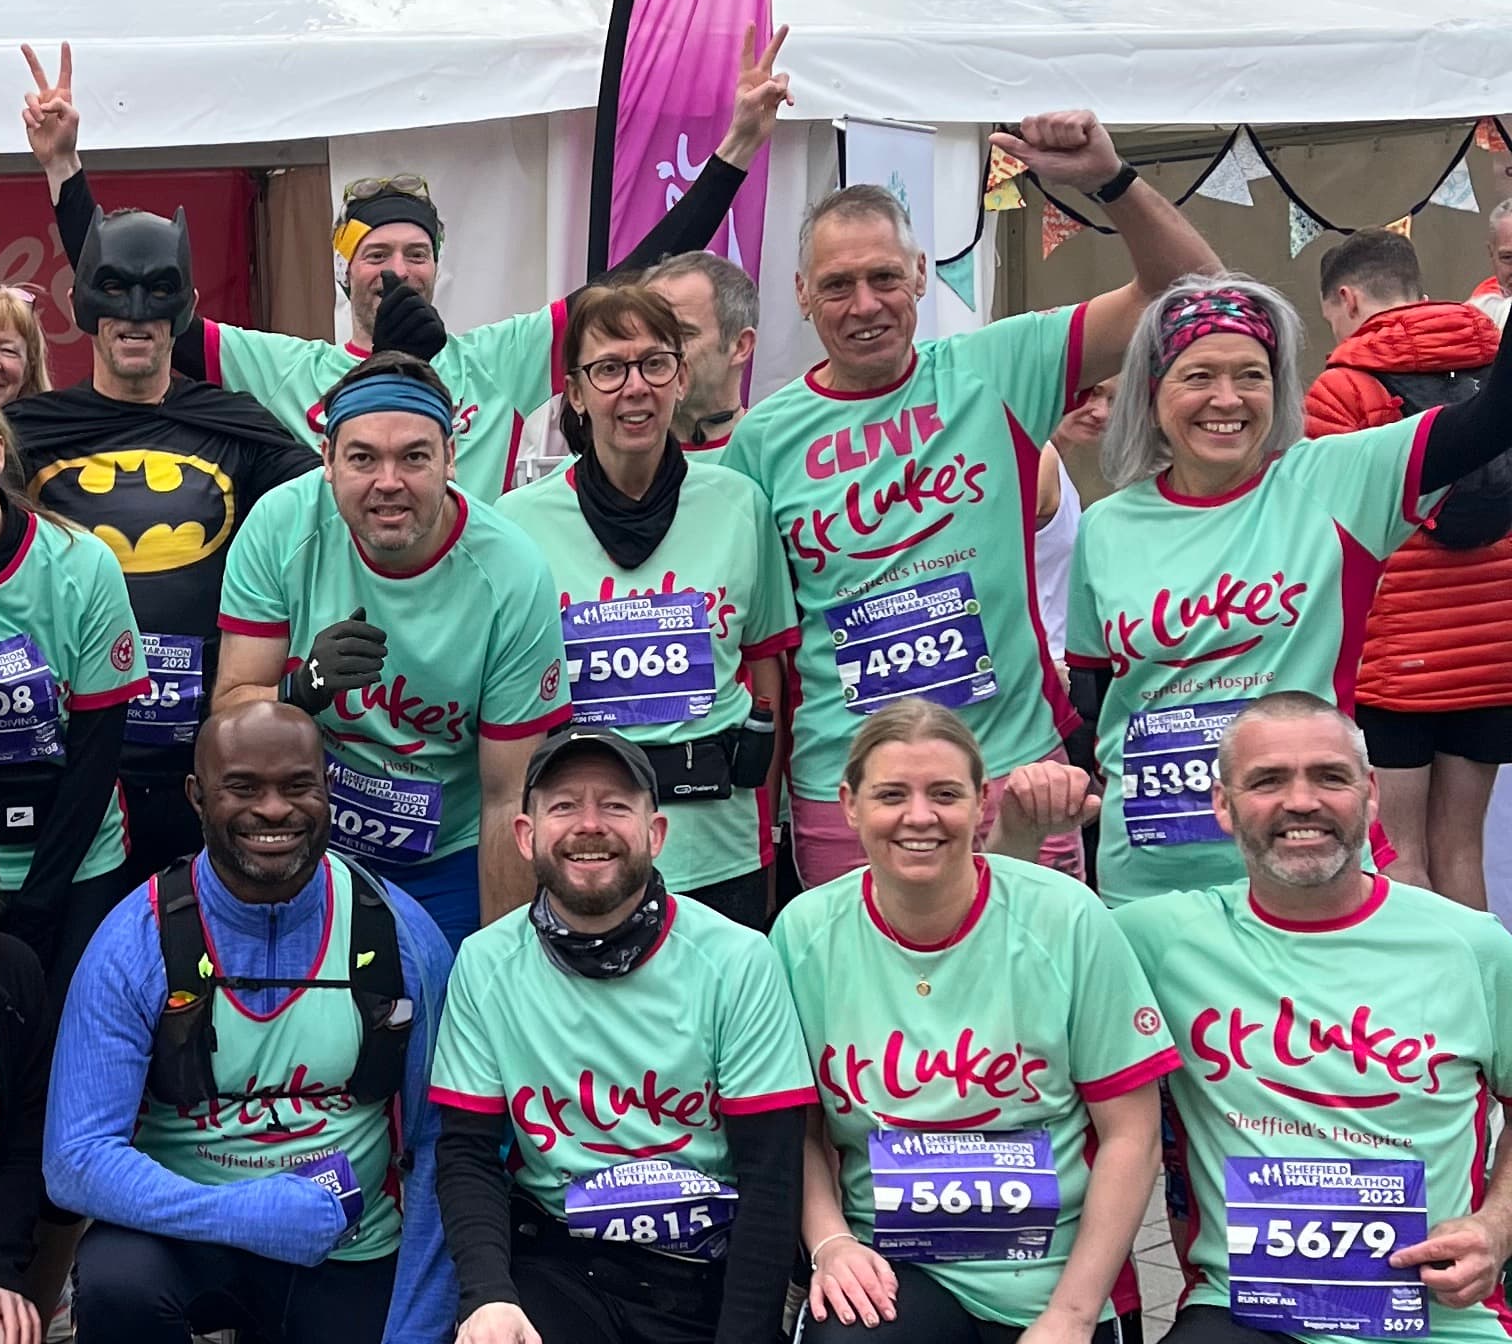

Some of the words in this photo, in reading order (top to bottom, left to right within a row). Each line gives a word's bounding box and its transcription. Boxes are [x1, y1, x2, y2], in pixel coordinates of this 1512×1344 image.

[805, 403, 945, 481] CLIVE
[790, 509, 842, 574] St
[846, 453, 988, 536] Luke's
[913, 547, 977, 573] Hospice
[601, 601, 650, 613] SHEFFIELD
[867, 592, 916, 612] SHEFFIELD
[869, 607, 895, 621] HALF
[897, 590, 959, 612] MARATHON
[928, 600, 964, 618] 2023
[630, 606, 691, 619] MARATHON
[658, 617, 694, 630] 2023
[1104, 611, 1145, 679] St
[1152, 571, 1308, 647] Luke's
[866, 628, 968, 678] 4982
[0, 658, 32, 676] 2023
[162, 657, 191, 668] 2023
[588, 643, 689, 682] 5068
[1208, 670, 1275, 692] Hospice
[588, 714, 603, 722] FOR
[603, 713, 616, 721] ALL
[1148, 711, 1192, 724] SHEFFIELD
[1204, 729, 1224, 742] 20
[343, 768, 391, 791] SHEFFIELD
[367, 785, 428, 805] MARATHON
[392, 802, 427, 817] 2023
[339, 835, 376, 854] PETER
[1190, 1007, 1264, 1081] St
[1274, 996, 1459, 1094] Luke's
[818, 1043, 874, 1115] St
[883, 1027, 1049, 1104] Luke's
[511, 1085, 575, 1153] St
[578, 1069, 721, 1132] Luke's
[925, 1133, 983, 1144] SHEFFIELD
[1226, 1112, 1327, 1140] Sheffield's
[1333, 1126, 1413, 1150] Hospice
[195, 1143, 276, 1169] Sheffield's
[959, 1142, 1032, 1154] MARATHON
[615, 1162, 669, 1175] SHEFFIELD
[993, 1153, 1036, 1167] 2023
[616, 1173, 646, 1187] HALF
[647, 1170, 712, 1183] MARATHO
[1285, 1164, 1349, 1176] SHEFFIELD
[679, 1181, 721, 1195] 2023
[1285, 1175, 1320, 1187] HALF
[1322, 1177, 1403, 1189] MARATHON
[910, 1180, 1032, 1214] 5619
[1359, 1190, 1406, 1205] 2023
[602, 1205, 713, 1244] 4815
[1266, 1219, 1396, 1258] 5679
[1238, 1295, 1258, 1304] RUN
[1260, 1296, 1278, 1305] FOR
[1280, 1298, 1297, 1306] ALL
[1383, 1318, 1425, 1331] 5679
